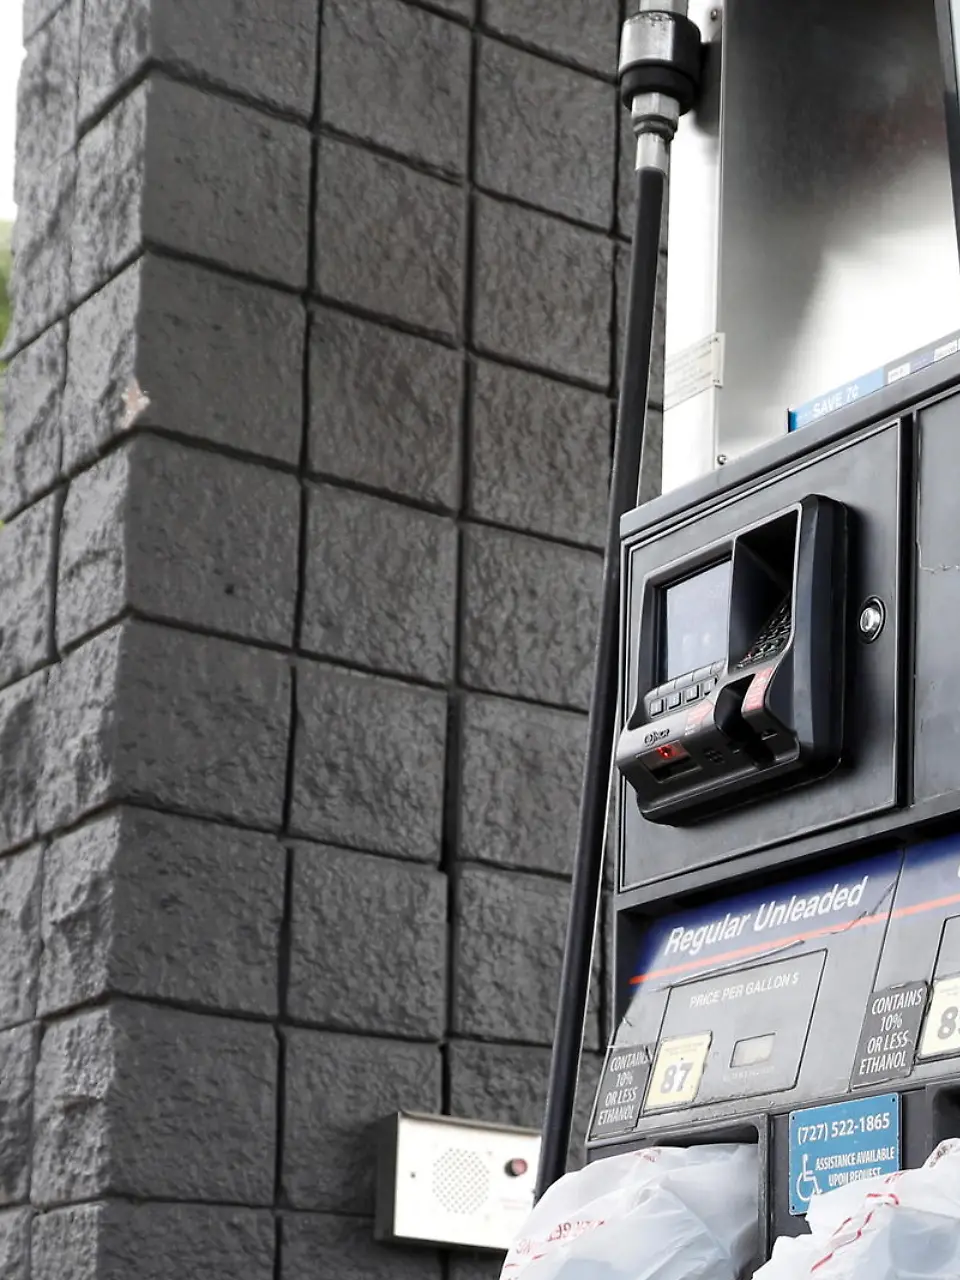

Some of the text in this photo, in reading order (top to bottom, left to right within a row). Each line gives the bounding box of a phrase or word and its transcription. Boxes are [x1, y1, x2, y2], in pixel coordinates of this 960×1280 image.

[664, 875, 869, 958] Regular Unleaded
[690, 990, 722, 1009] PRICE
[721, 984, 743, 1001] PER
[745, 973, 792, 996] GALLON
[871, 986, 923, 1017] CONTAINS
[879, 1012, 903, 1033] 10%
[867, 1030, 910, 1055] OR LESS
[610, 1051, 650, 1073] CONTAINS
[859, 1049, 907, 1077] ETHANOL
[616, 1070, 635, 1089] 10%
[660, 1061, 695, 1095] 87
[605, 1085, 638, 1108] OR LESS
[597, 1104, 634, 1127] ETHANOL
[797, 1111, 891, 1146] (727) 522-1865
[815, 1146, 896, 1172] ASSISTANCE AVAILABLE
[828, 1171, 846, 1187] UPON
